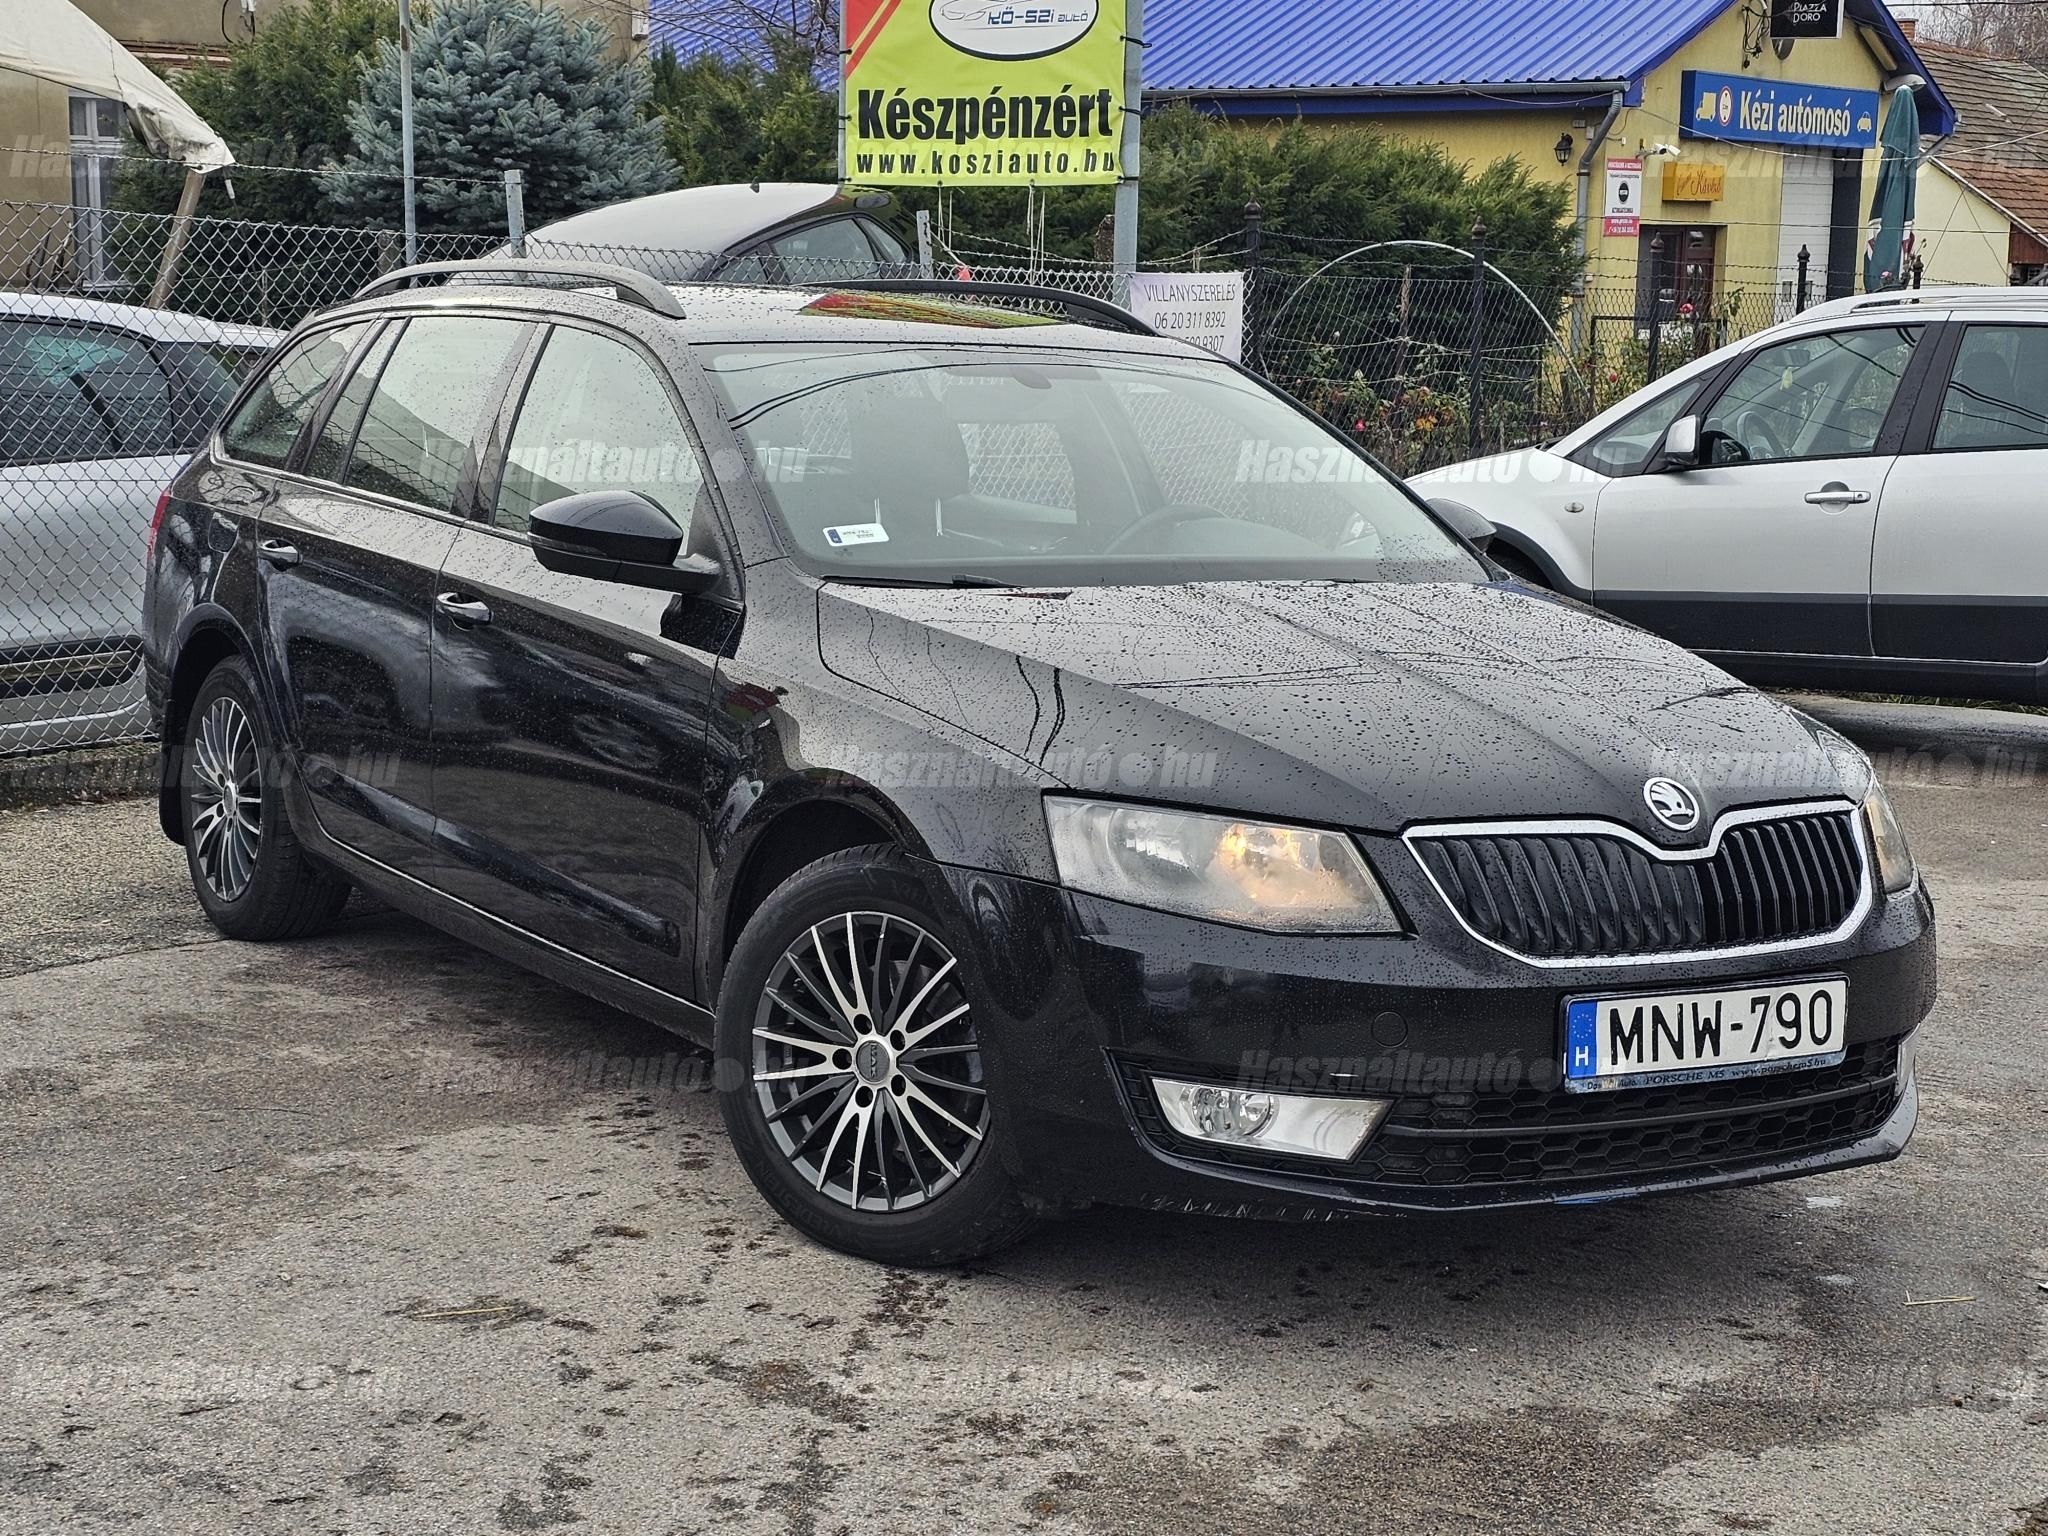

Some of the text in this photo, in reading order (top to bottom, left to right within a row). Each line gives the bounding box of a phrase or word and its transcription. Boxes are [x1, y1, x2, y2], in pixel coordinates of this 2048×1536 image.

[1794, 2, 1827, 12] PIAZZA
[858, 85, 1113, 145] Készpénzért
[1740, 89, 1851, 137] Kézi autómosó
[857, 150, 1115, 174] www.kosziauto.hu
[1144, 280, 1236, 302] VILLANYSZERELÉS
[1154, 311, 1226, 329] 06 20 311 8392
[1609, 990, 1833, 1066] MNW-790
[1575, 1046, 1589, 1067] H
[1646, 1072, 1704, 1085] PORSCHE
